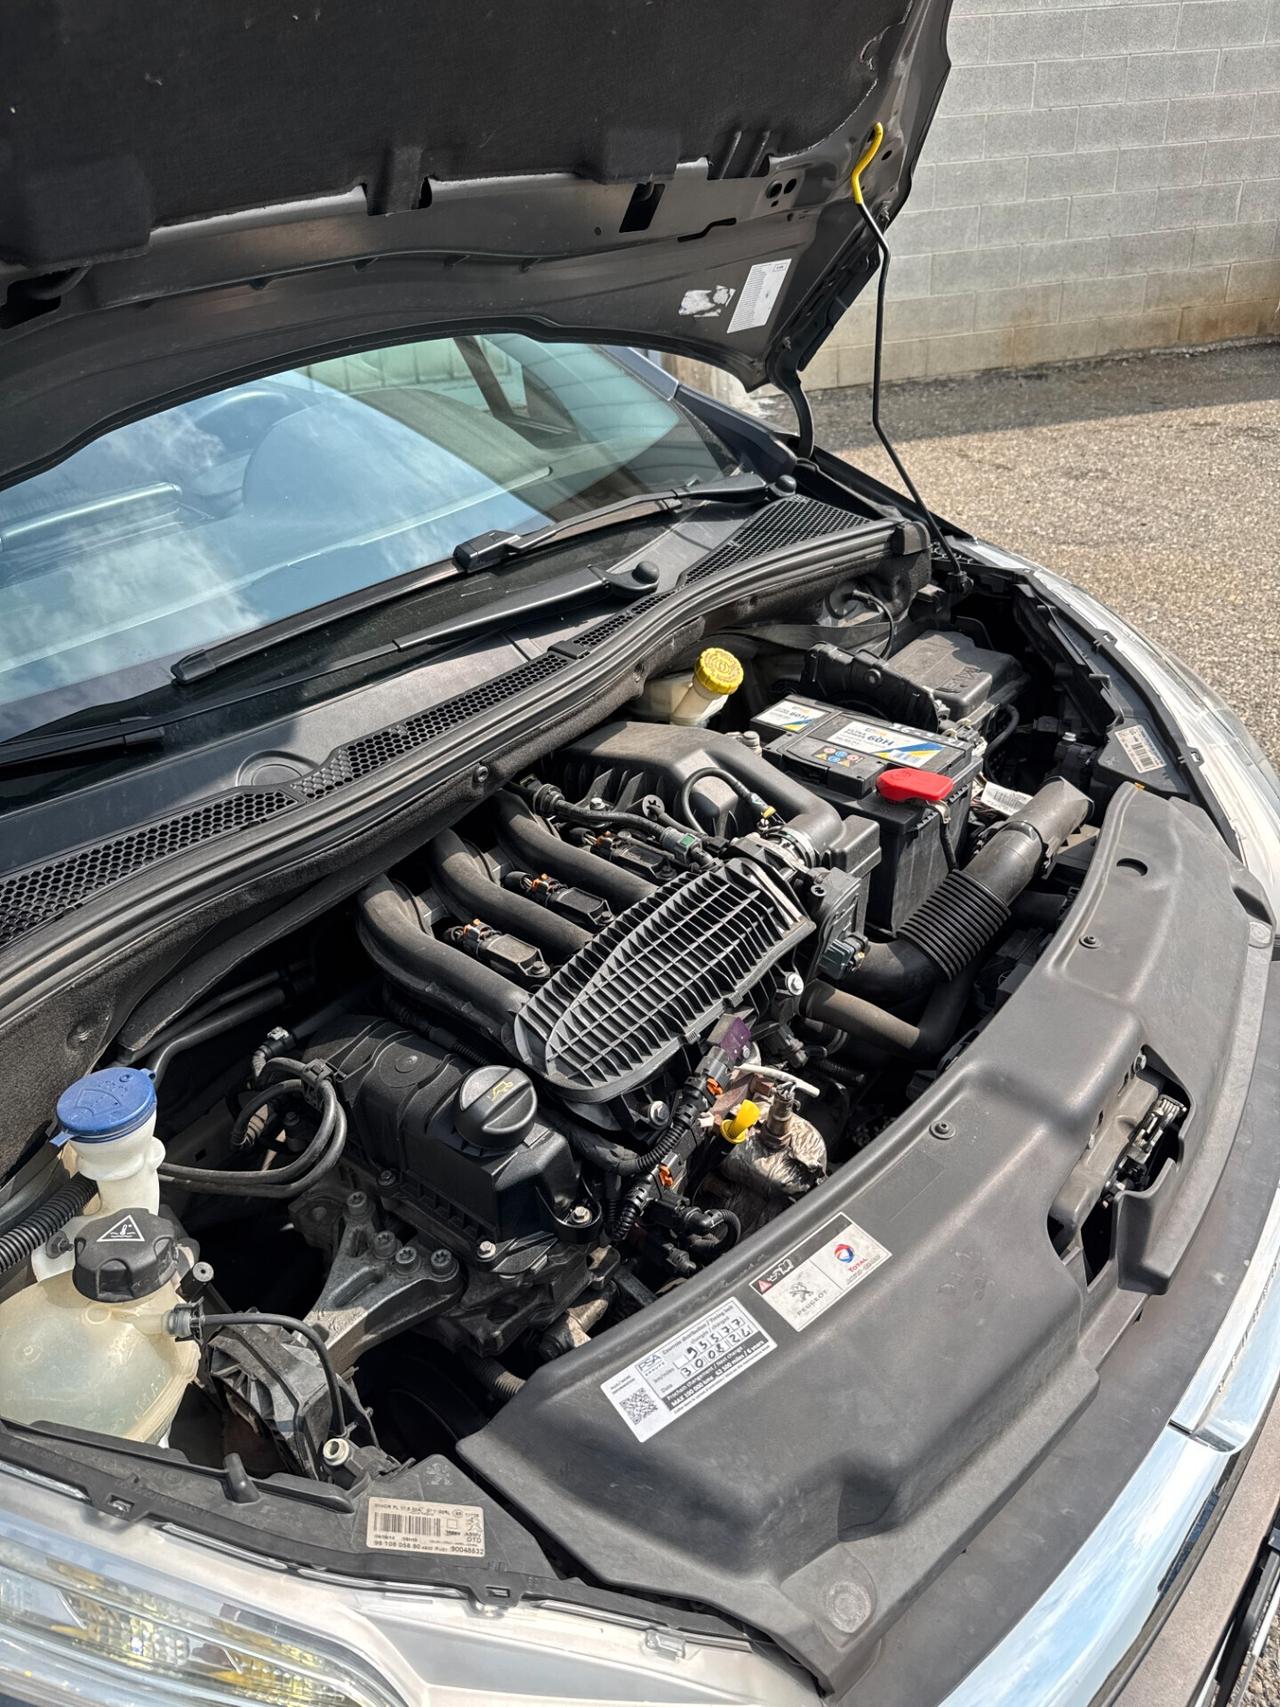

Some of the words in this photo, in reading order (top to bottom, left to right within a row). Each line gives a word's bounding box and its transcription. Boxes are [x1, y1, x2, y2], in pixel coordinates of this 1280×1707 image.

[847, 1256, 867, 1273] TOTAL
[796, 1289, 828, 1316] PEUGEOT
[637, 1352, 661, 1371] PSA
